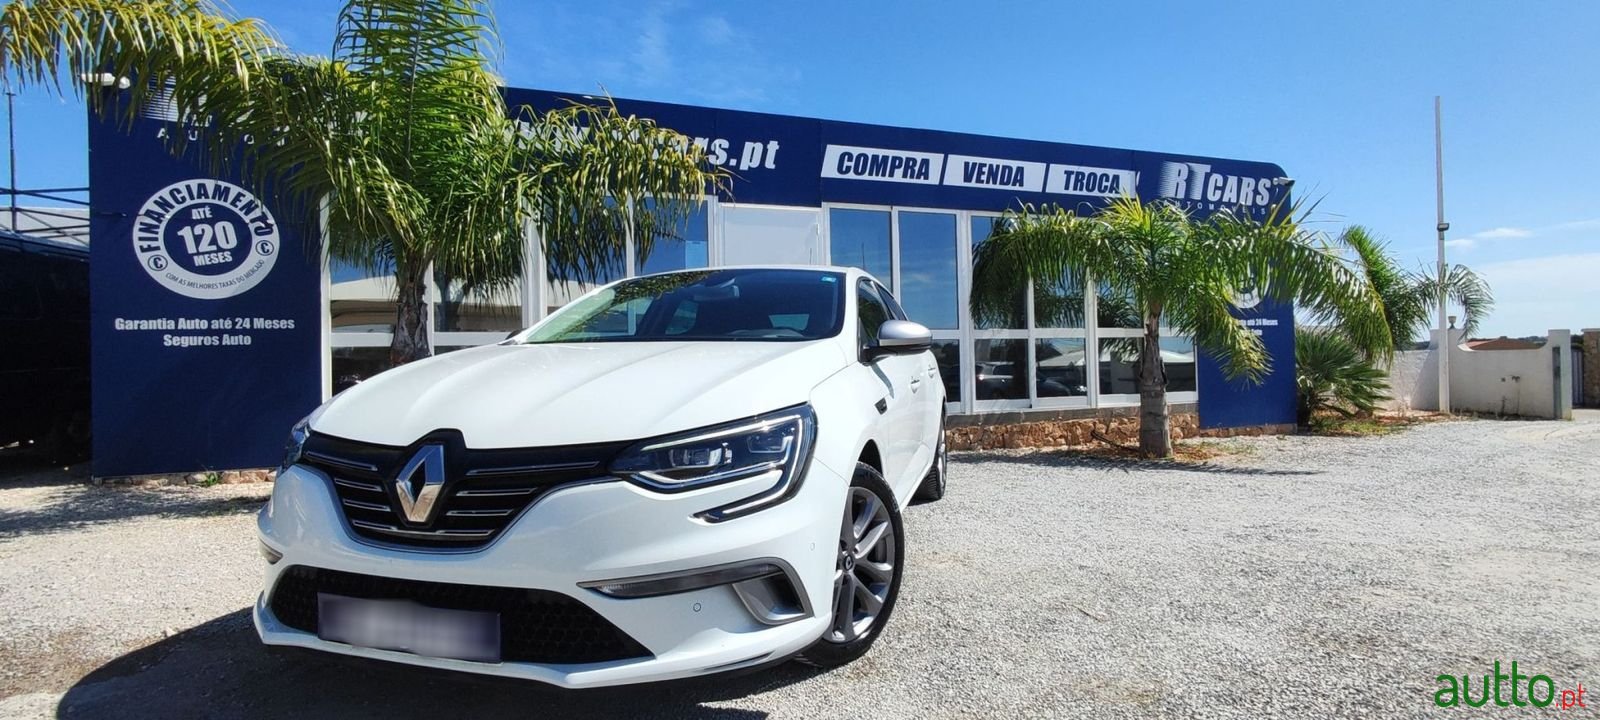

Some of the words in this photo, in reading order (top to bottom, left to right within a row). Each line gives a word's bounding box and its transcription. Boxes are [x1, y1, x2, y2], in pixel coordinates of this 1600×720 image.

[836, 151, 930, 181] COMPRA
[963, 161, 1025, 187] VENDA
[1063, 169, 1121, 194] TROCA
[138, 183, 274, 254] FINANCIAMENTO
[191, 206, 213, 220] ATÉ
[177, 221, 238, 254] 120
[193, 252, 233, 267] MESES
[165, 272, 178, 282] COM
[179, 278, 187, 286] AS
[186, 281, 219, 290] MELHORES
[218, 279, 237, 289] TAXAS
[236, 276, 245, 284] DO
[244, 260, 265, 280] MERCADO
[114, 317, 176, 330] Garantia
[177, 317, 209, 330] Auto
[211, 317, 233, 330] até
[234, 317, 251, 330] 24
[253, 317, 295, 329] Meses
[163, 334, 220, 348] Seguros
[222, 334, 252, 346] Auto
